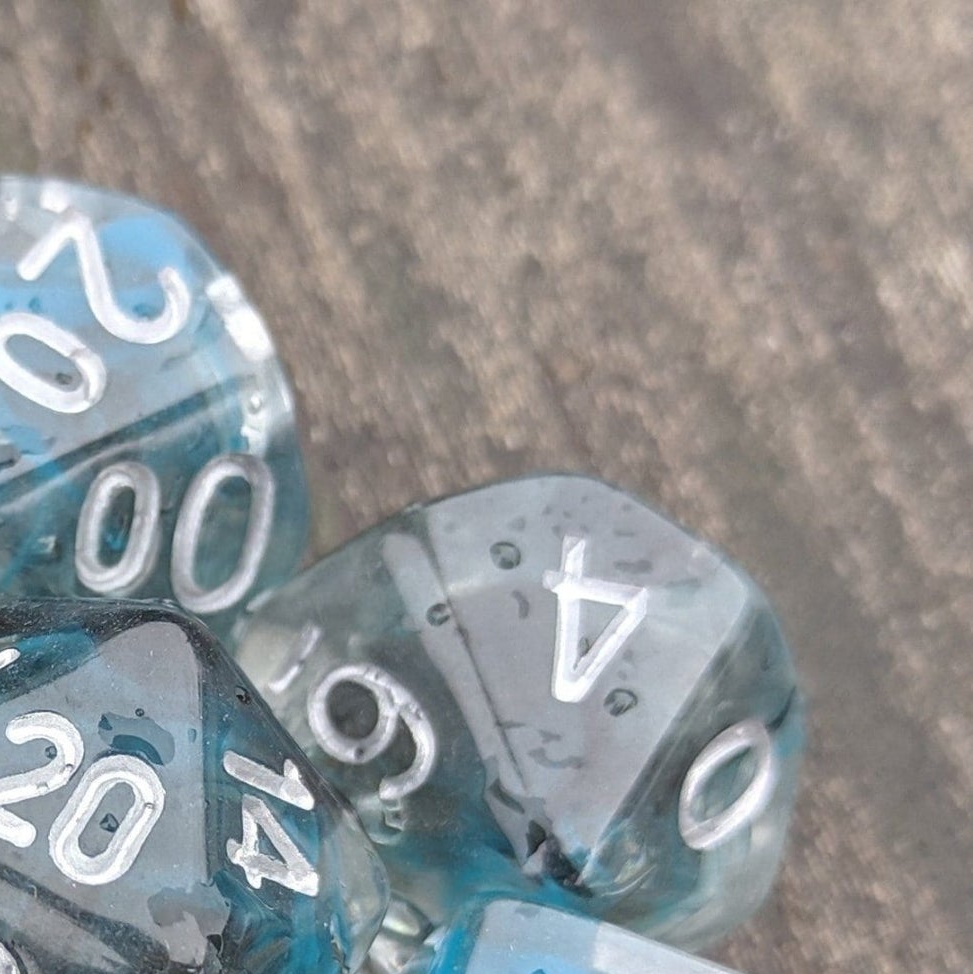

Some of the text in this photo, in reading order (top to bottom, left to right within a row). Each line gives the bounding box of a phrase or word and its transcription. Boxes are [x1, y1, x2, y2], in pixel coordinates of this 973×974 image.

[75, 454, 275, 615] 00
[543, 535, 648, 703] 4
[222, 750, 320, 897] 14
[679, 718, 775, 851] 0
